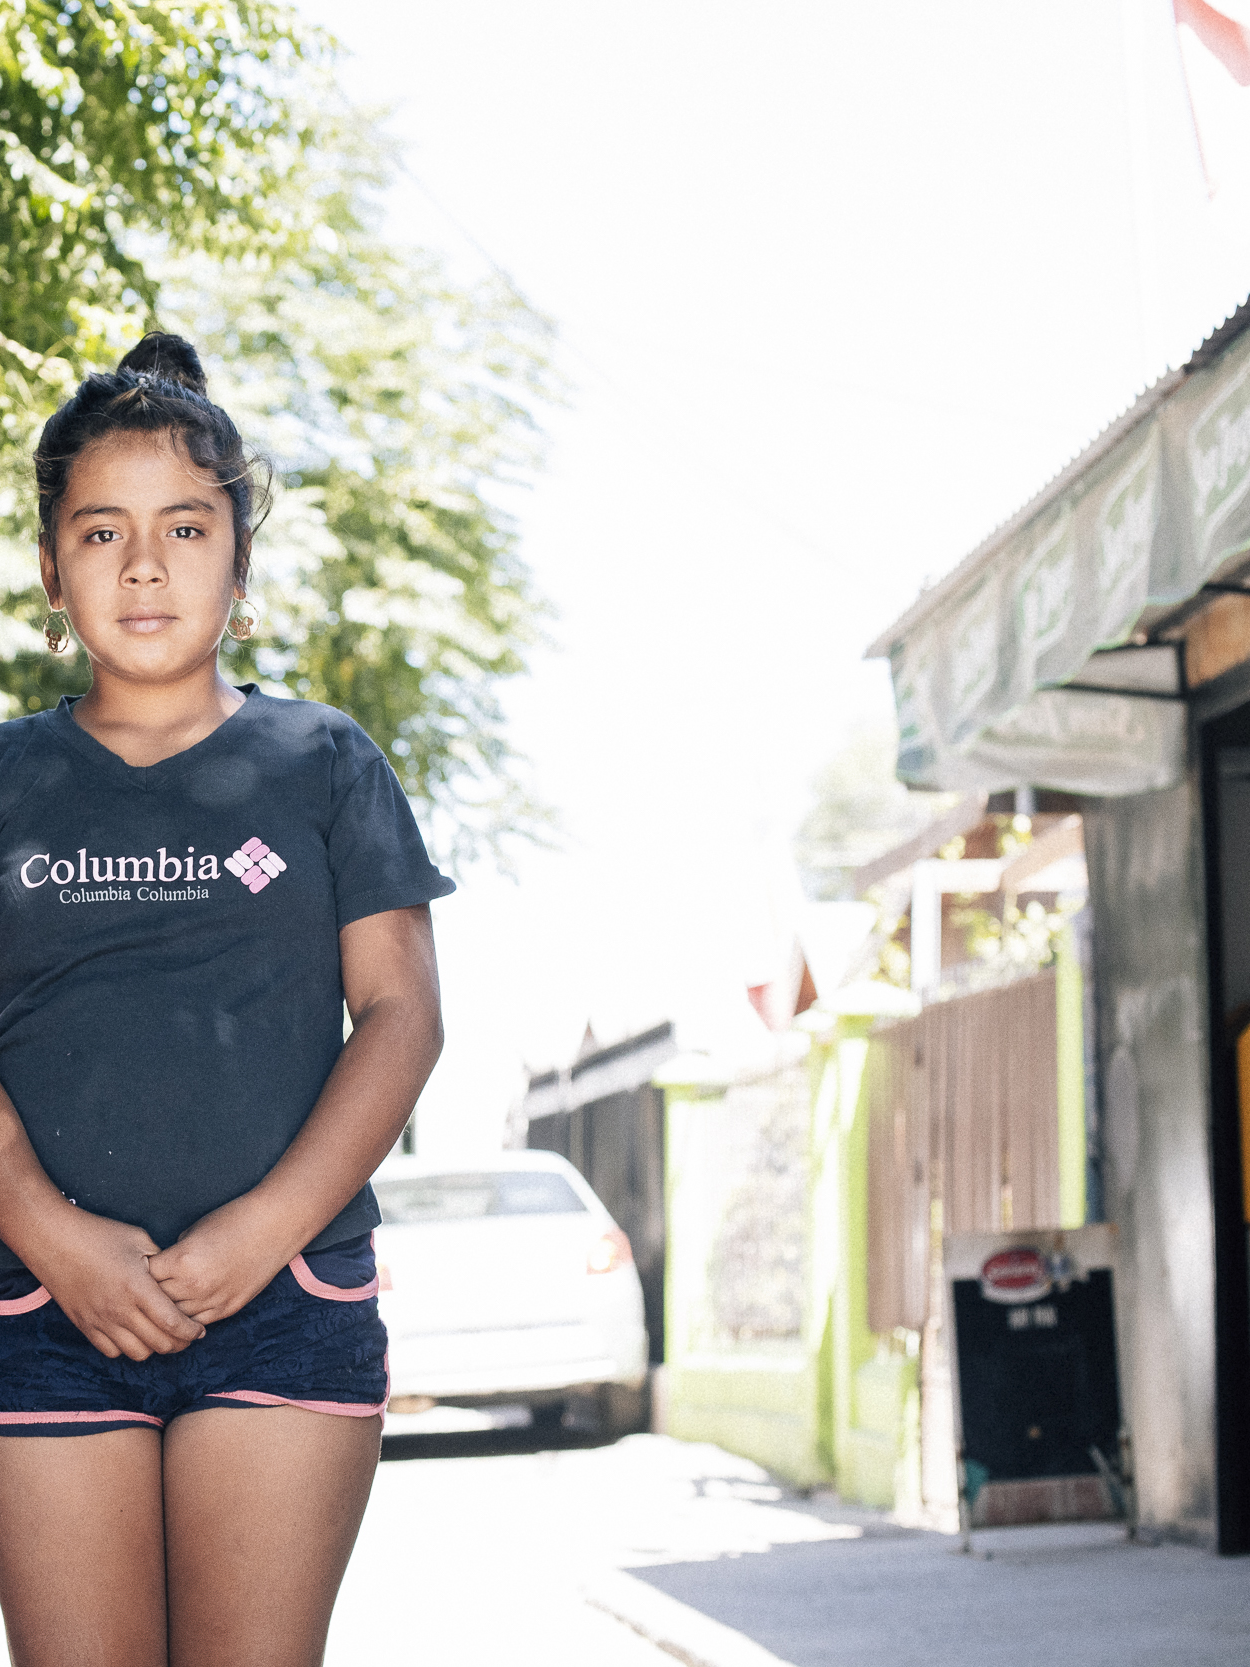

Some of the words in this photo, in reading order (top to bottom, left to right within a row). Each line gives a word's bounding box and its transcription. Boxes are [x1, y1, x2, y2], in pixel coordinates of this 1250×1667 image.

[20, 846, 221, 888] Columbia
[59, 887, 132, 904] Columbia
[136, 886, 210, 902] Columbia
